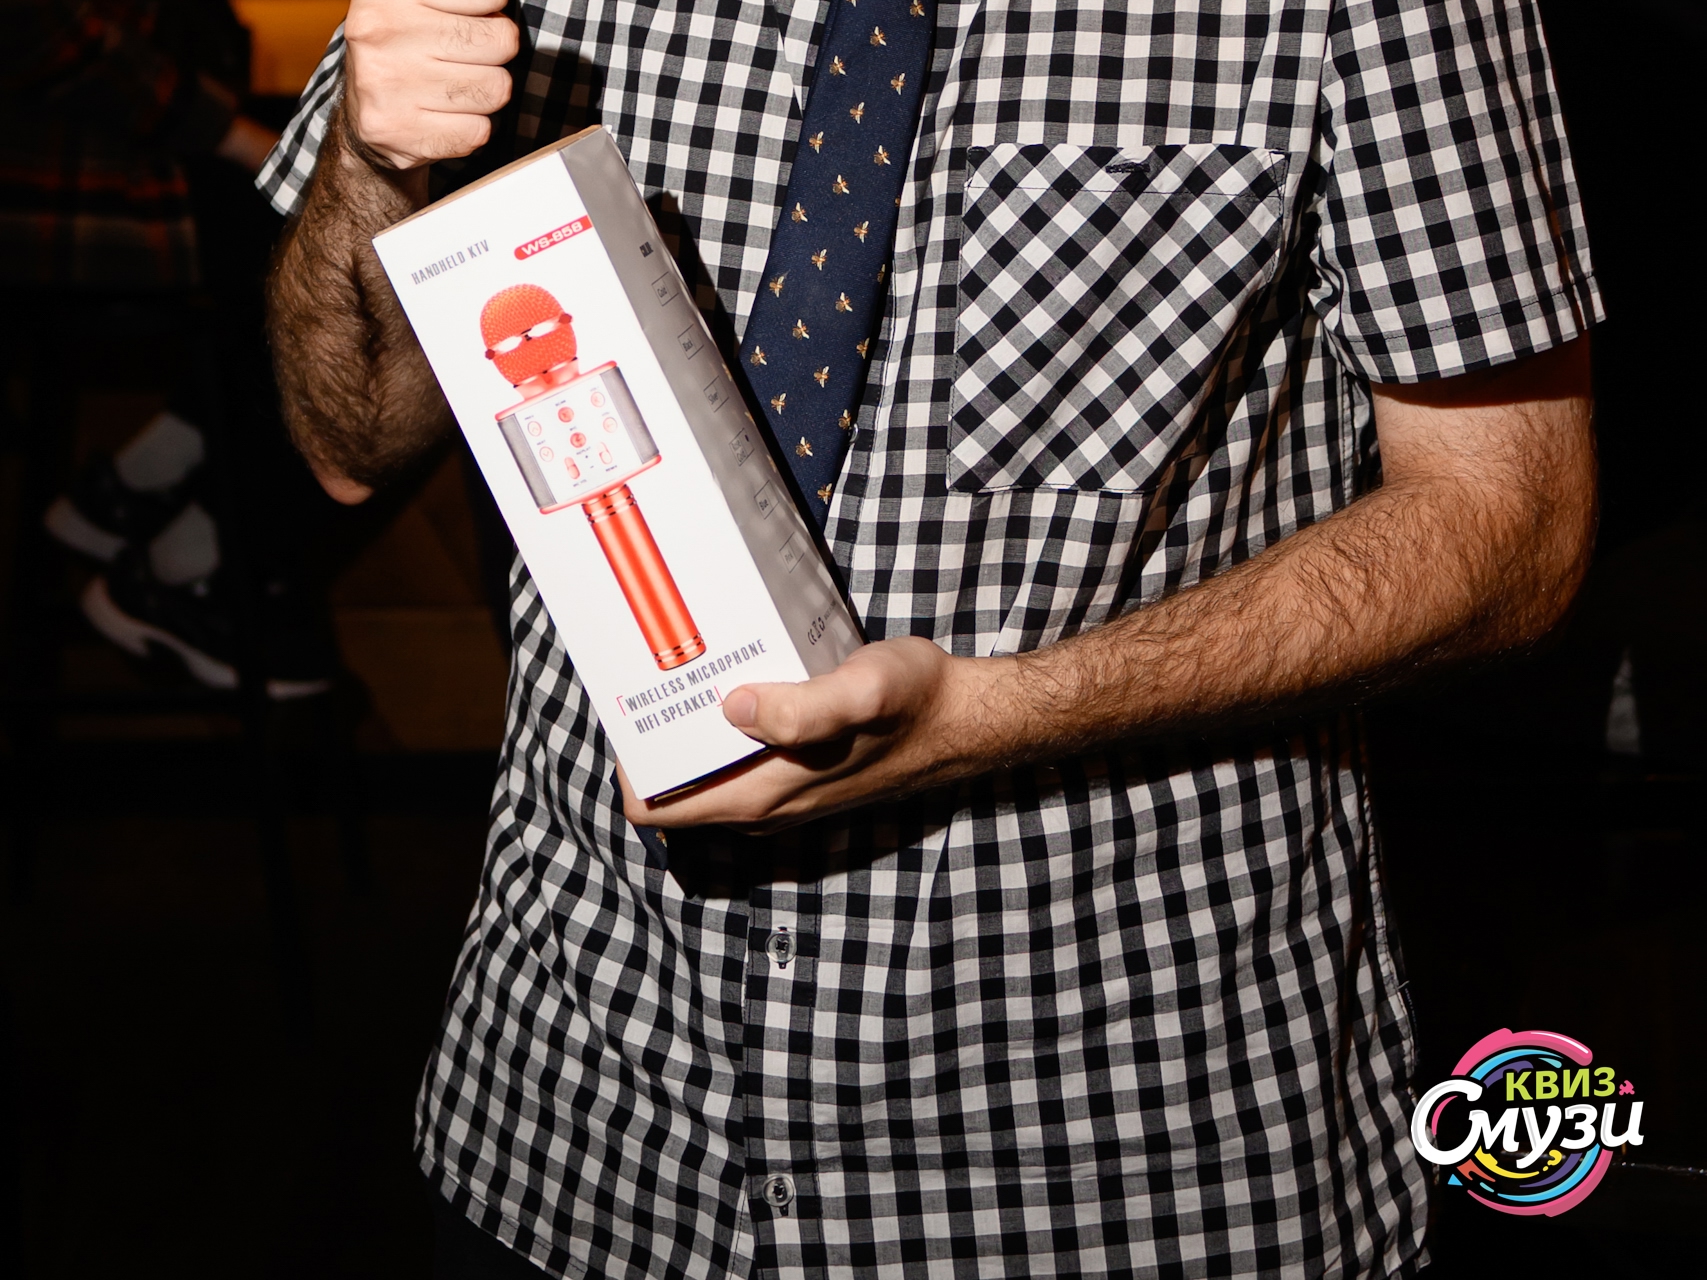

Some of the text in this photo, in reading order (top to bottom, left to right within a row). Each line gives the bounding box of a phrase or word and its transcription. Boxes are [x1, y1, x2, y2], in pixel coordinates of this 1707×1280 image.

[521, 221, 583, 256] WS-858
[411, 239, 490, 285] HANDHELD KTV
[625, 639, 767, 712] WIRELESS MICROPHONE
[634, 689, 717, 734] HIFI SPEAKER
